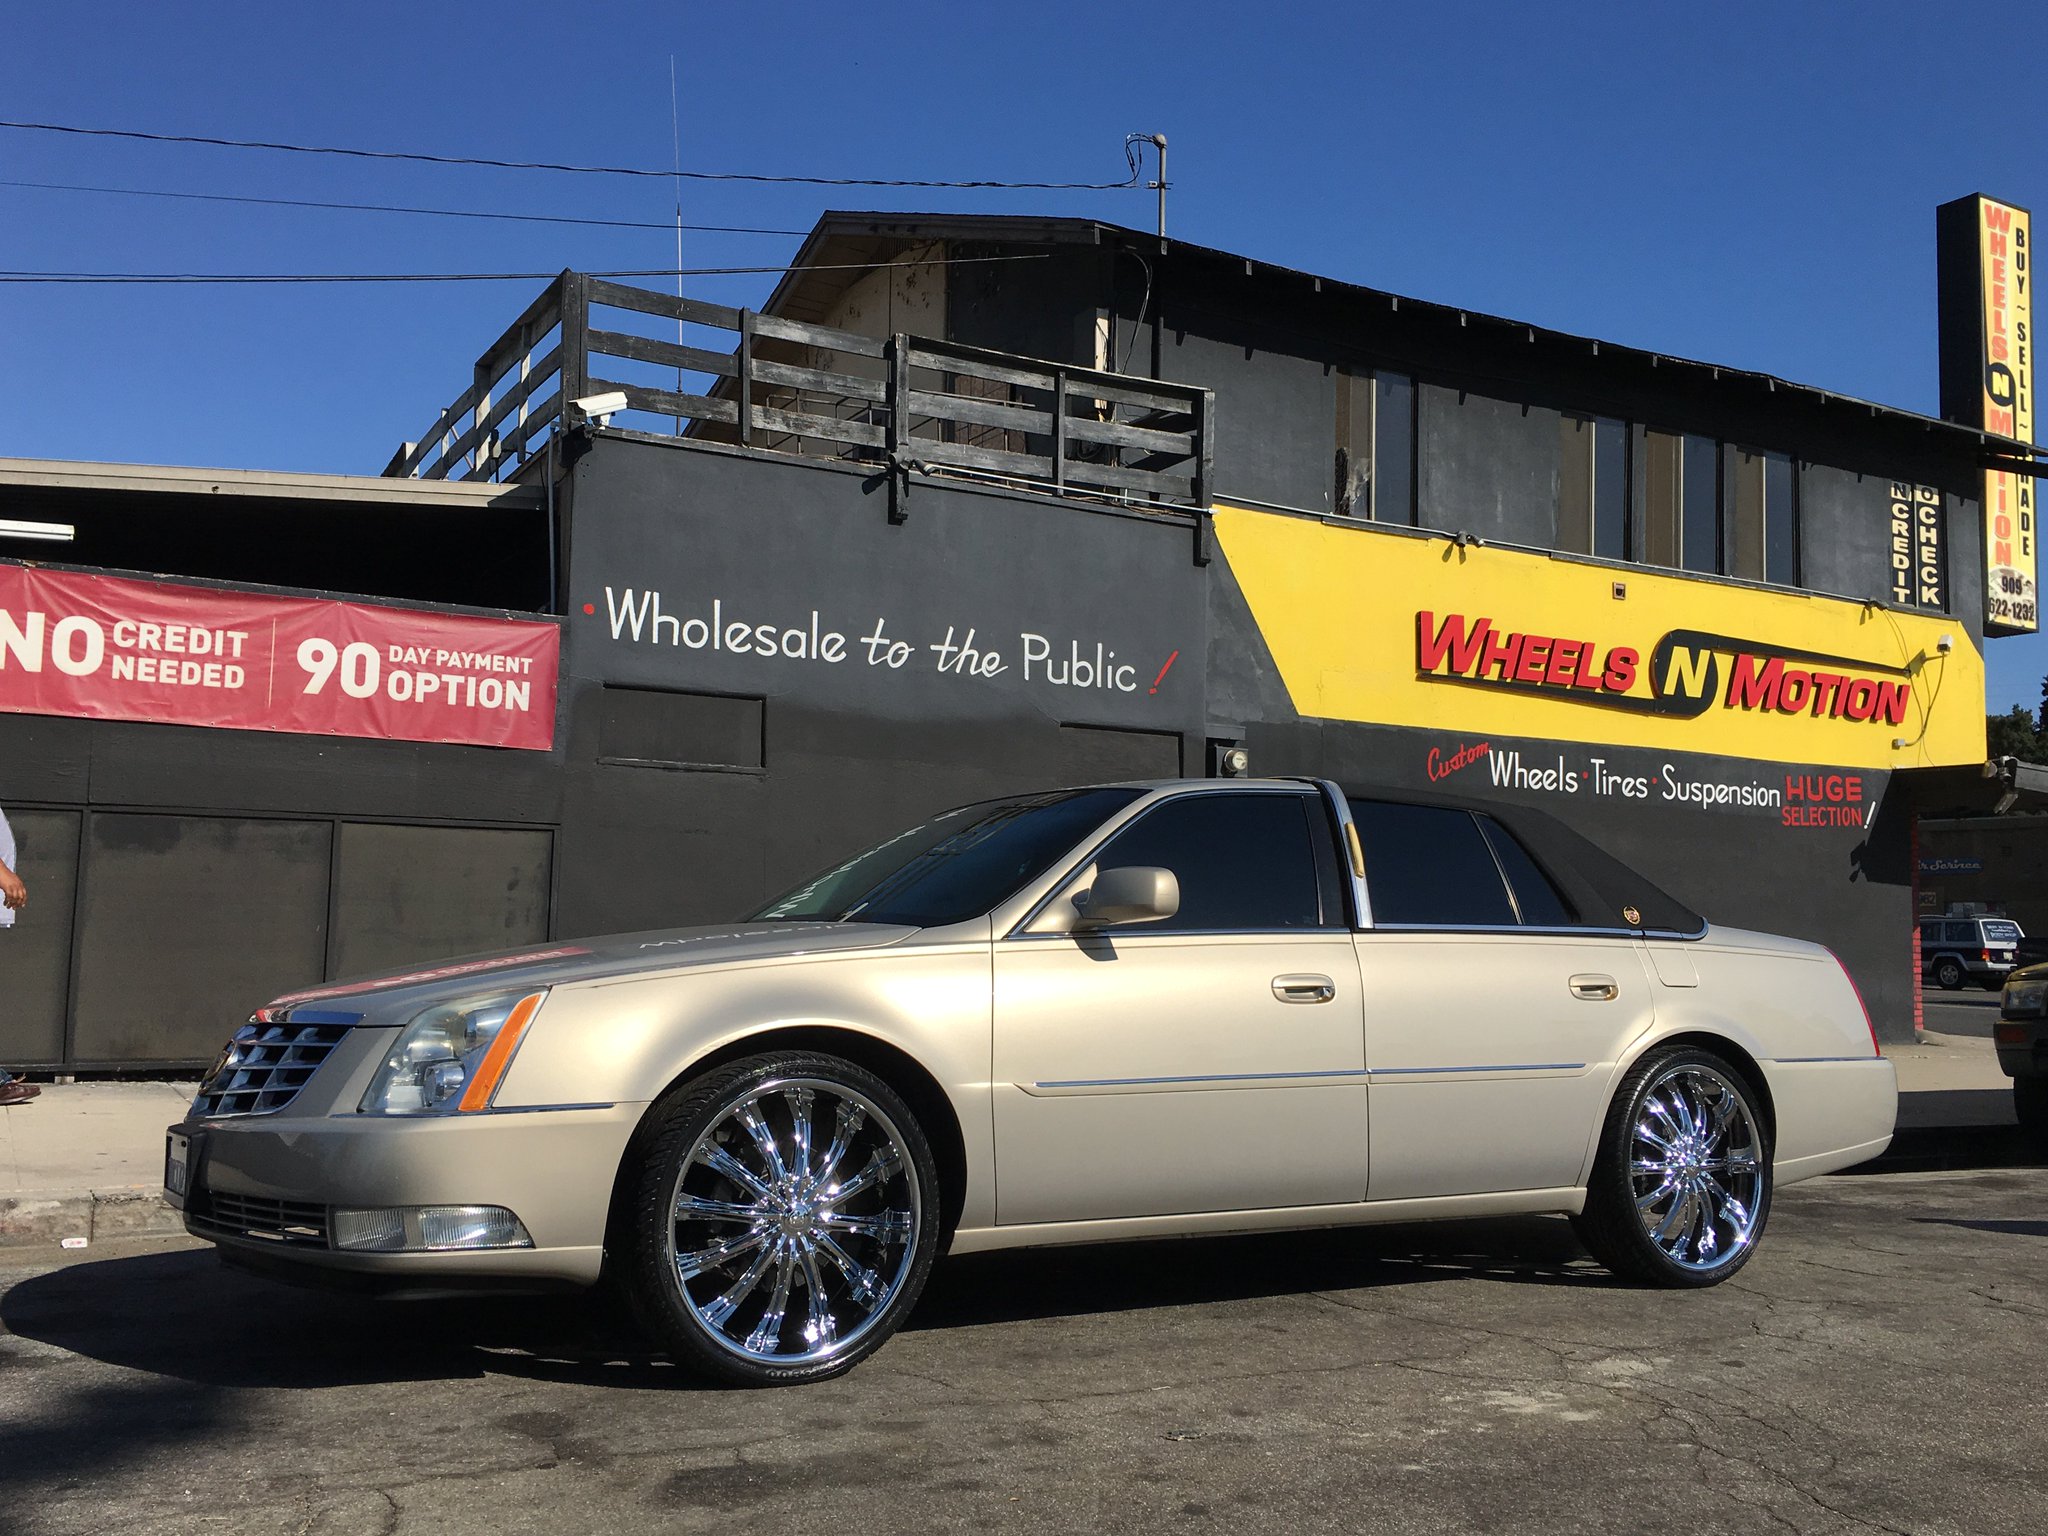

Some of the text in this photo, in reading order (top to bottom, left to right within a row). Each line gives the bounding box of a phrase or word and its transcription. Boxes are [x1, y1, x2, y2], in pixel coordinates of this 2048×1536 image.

[1984, 204, 2011, 361] WHEELS
[2015, 227, 2026, 295] BUY
[1991, 371, 2010, 398] N
[2016, 322, 2027, 413] SELL
[1891, 503, 1911, 603] CREDIT
[1918, 507, 1940, 605] CHECK
[2001, 575, 2023, 596] 909
[0, 608, 105, 677] NO
[111, 655, 245, 689] NEEDED
[112, 620, 249, 658] CREDIT
[296, 637, 381, 699] 90
[388, 645, 534, 675] DAY PAYMENT
[605, 586, 848, 663] Wholesale
[860, 617, 916, 669] to
[930, 626, 1009, 678] the
[1020, 633, 1138, 693] Public
[1418, 610, 1911, 724] WHEELS N MOTION
[387, 670, 531, 712] OPTION
[1427, 741, 1781, 810] Custom Wheels Tires Suspension
[1785, 774, 1863, 802] HUGE
